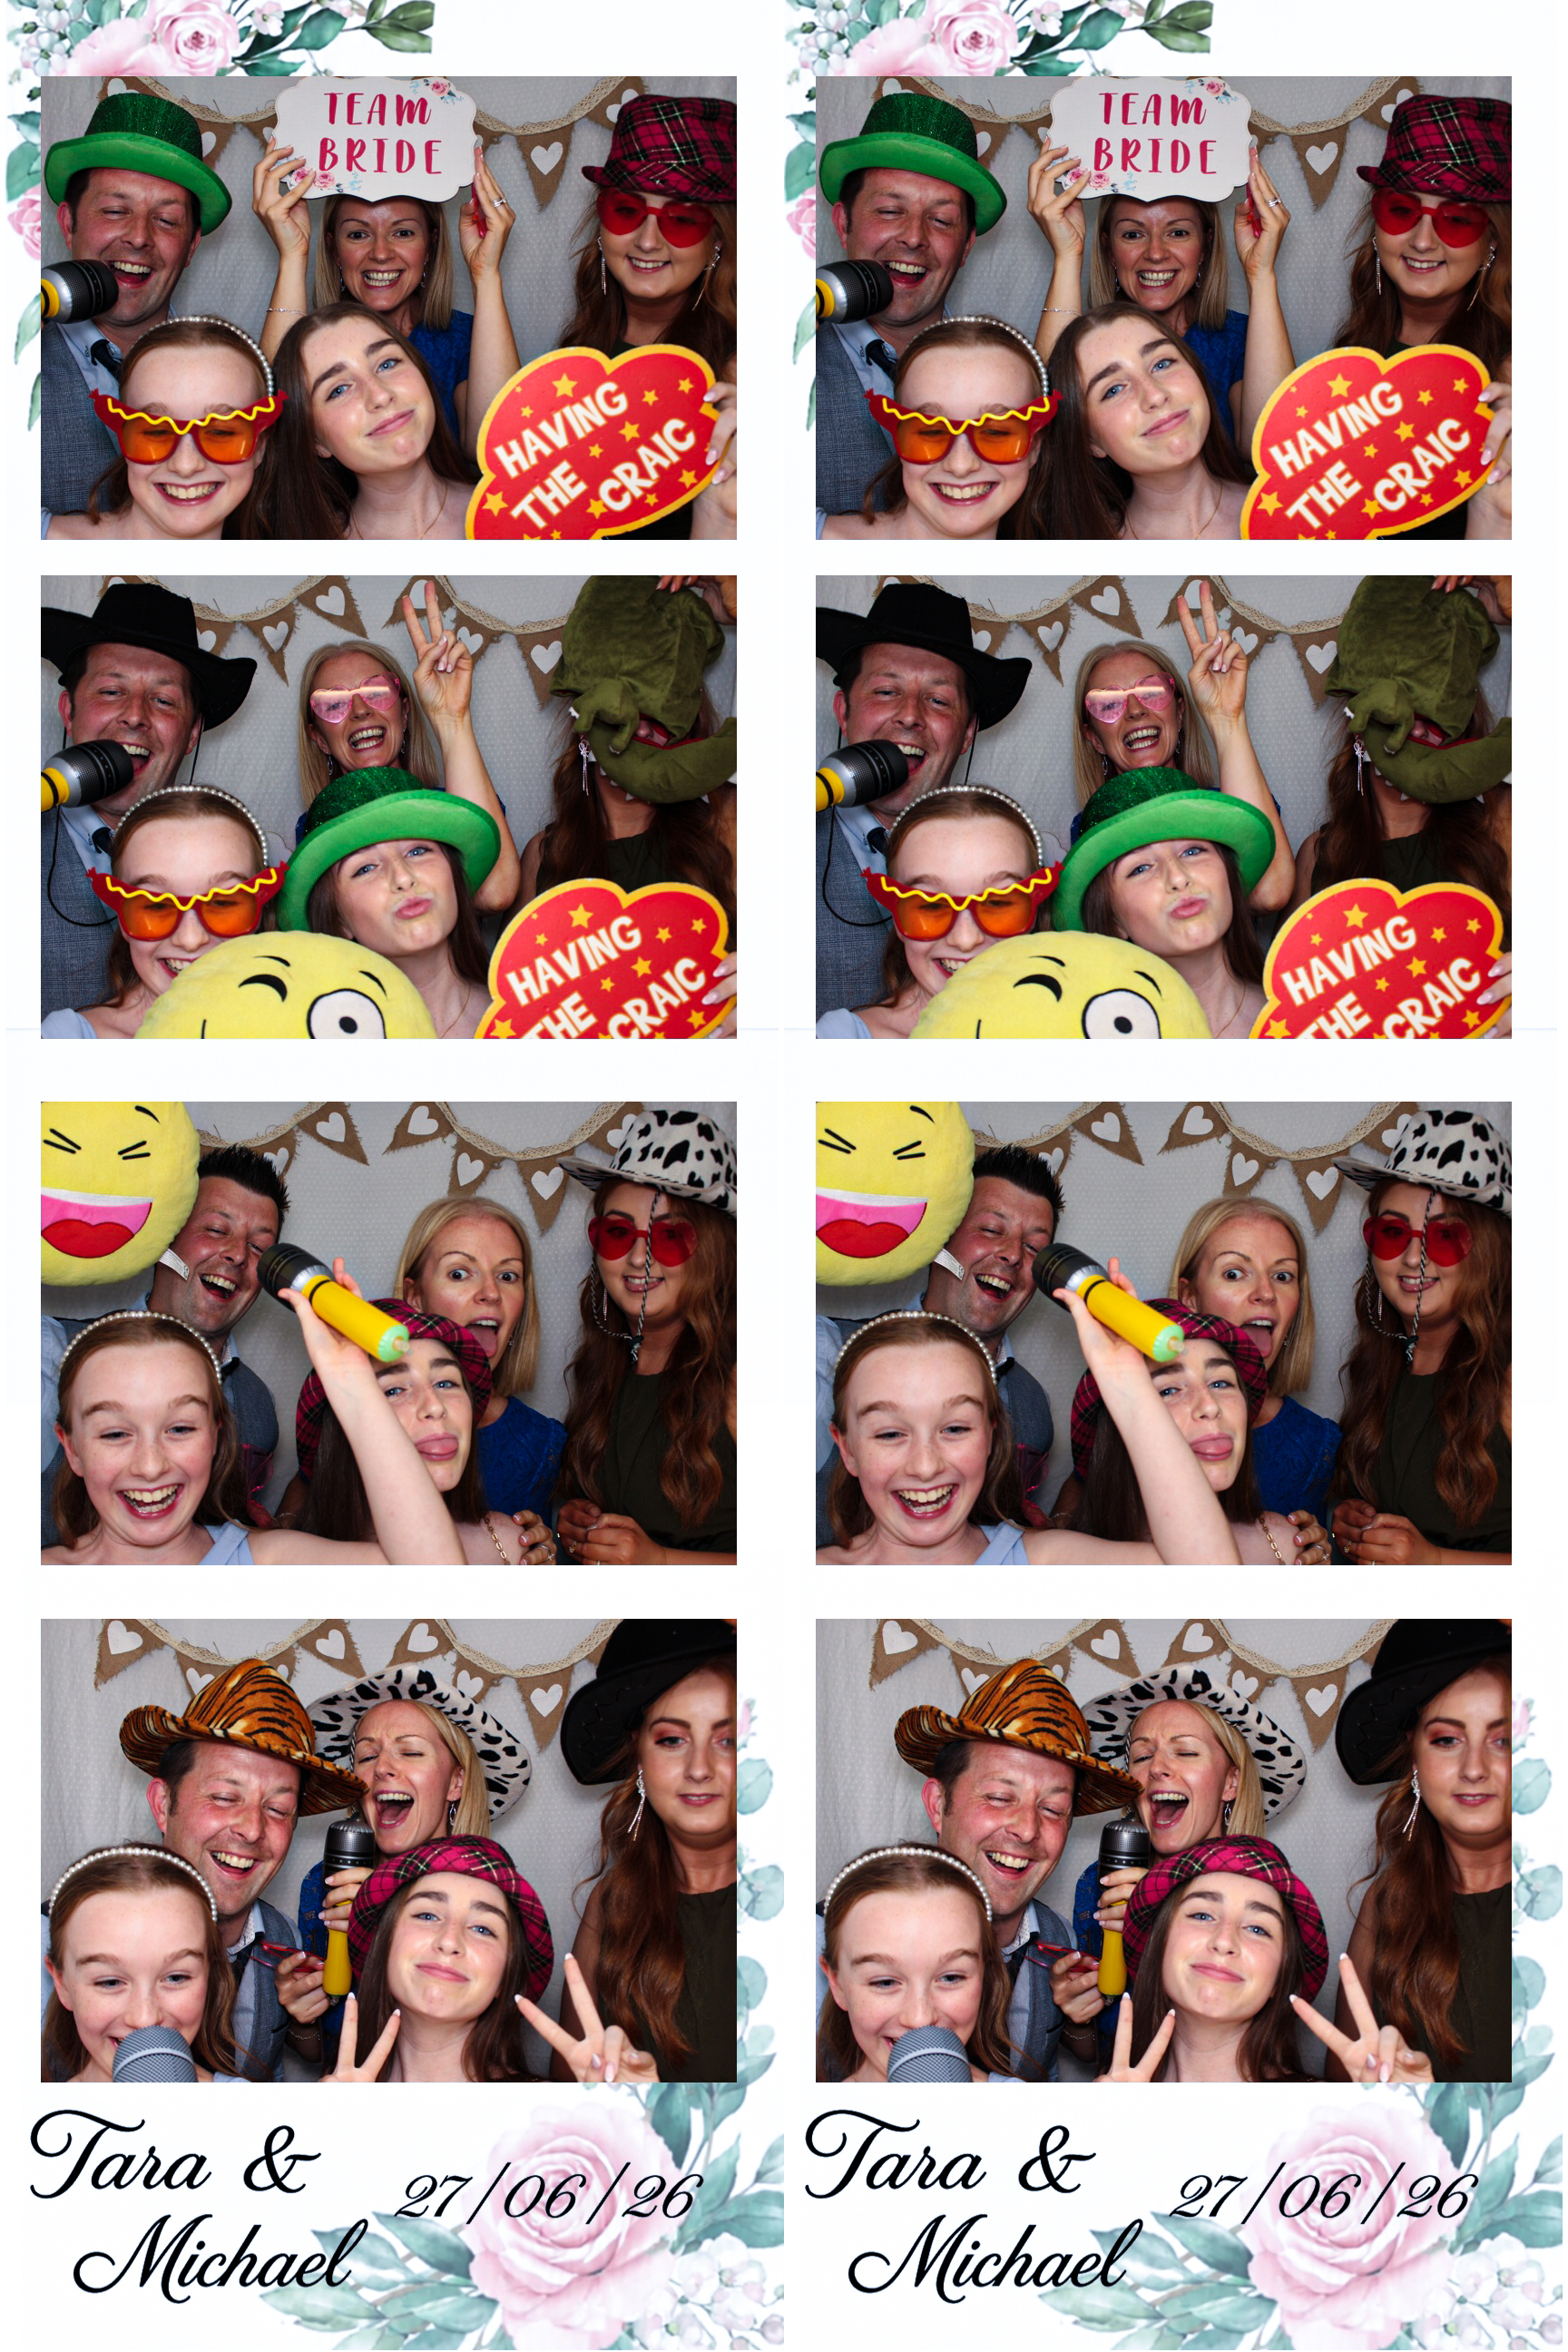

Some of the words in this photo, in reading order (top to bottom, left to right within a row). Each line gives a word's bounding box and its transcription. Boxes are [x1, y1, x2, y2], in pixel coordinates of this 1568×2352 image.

[324, 93, 432, 127] TEAM
[1099, 93, 1207, 127] TEAM
[318, 137, 443, 175] BRIDE
[1093, 137, 1218, 175] BRIDE
[494, 381, 628, 479] HAVING
[1269, 381, 1403, 479] HAVING
[510, 460, 588, 529] THE
[598, 418, 695, 512] CRAIC
[1285, 460, 1363, 529] THE
[1373, 418, 1470, 512] CRAIC
[505, 916, 642, 1007] HAVING
[608, 957, 706, 1039] CRAIC
[1280, 916, 1416, 1007] HAVING
[1383, 957, 1481, 1039] CRAIC
